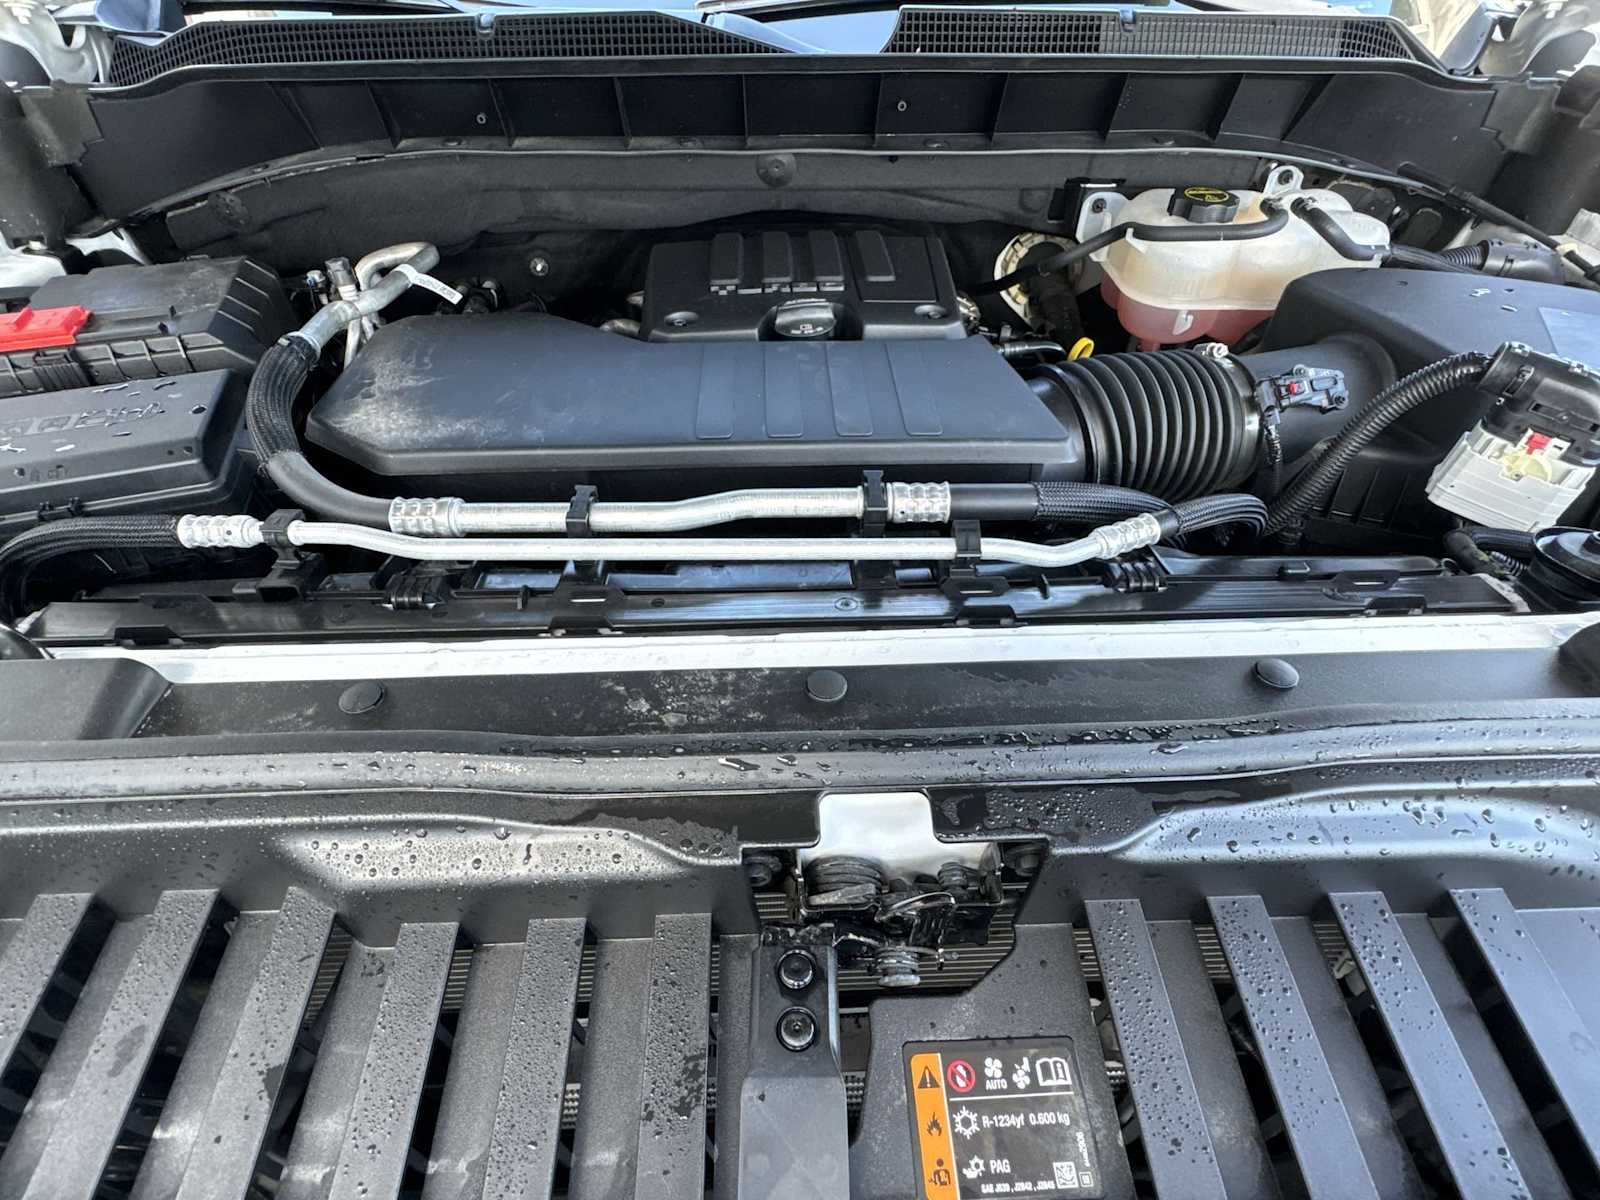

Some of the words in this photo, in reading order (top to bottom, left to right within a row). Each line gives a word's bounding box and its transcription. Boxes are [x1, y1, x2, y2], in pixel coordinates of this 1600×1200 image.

[985, 1078, 1008, 1091] AUTO
[982, 1113, 1025, 1129] R-1234yf
[1028, 1112, 1056, 1126] 0.600
[1057, 1111, 1071, 1126] kg
[989, 1158, 1011, 1174] PAG
